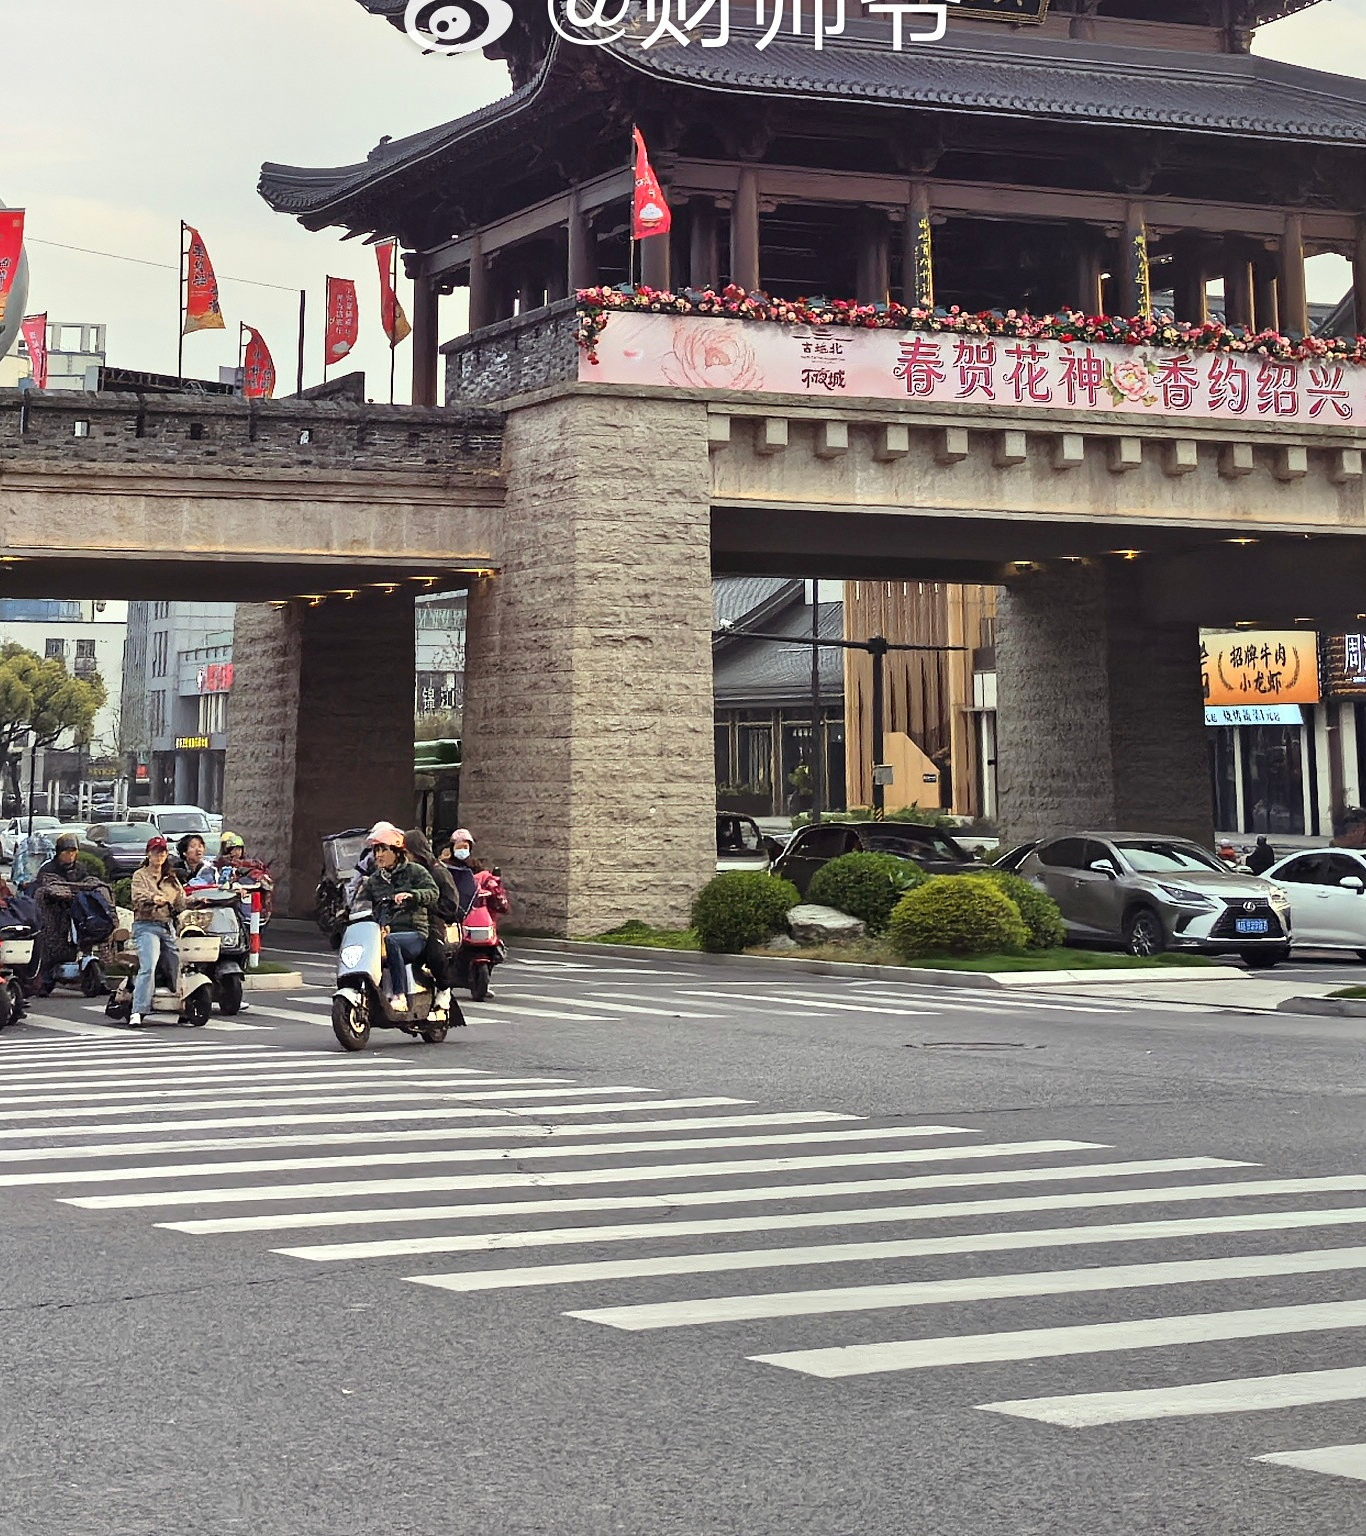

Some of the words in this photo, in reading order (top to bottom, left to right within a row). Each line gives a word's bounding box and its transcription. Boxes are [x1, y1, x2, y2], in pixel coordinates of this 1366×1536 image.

[893, 336, 1106, 407] 春贺花神
[1152, 353, 1354, 420] 香约绍兴
[1229, 642, 1287, 671] 招牌牛肉
[1239, 670, 1283, 695] 小龙虾
